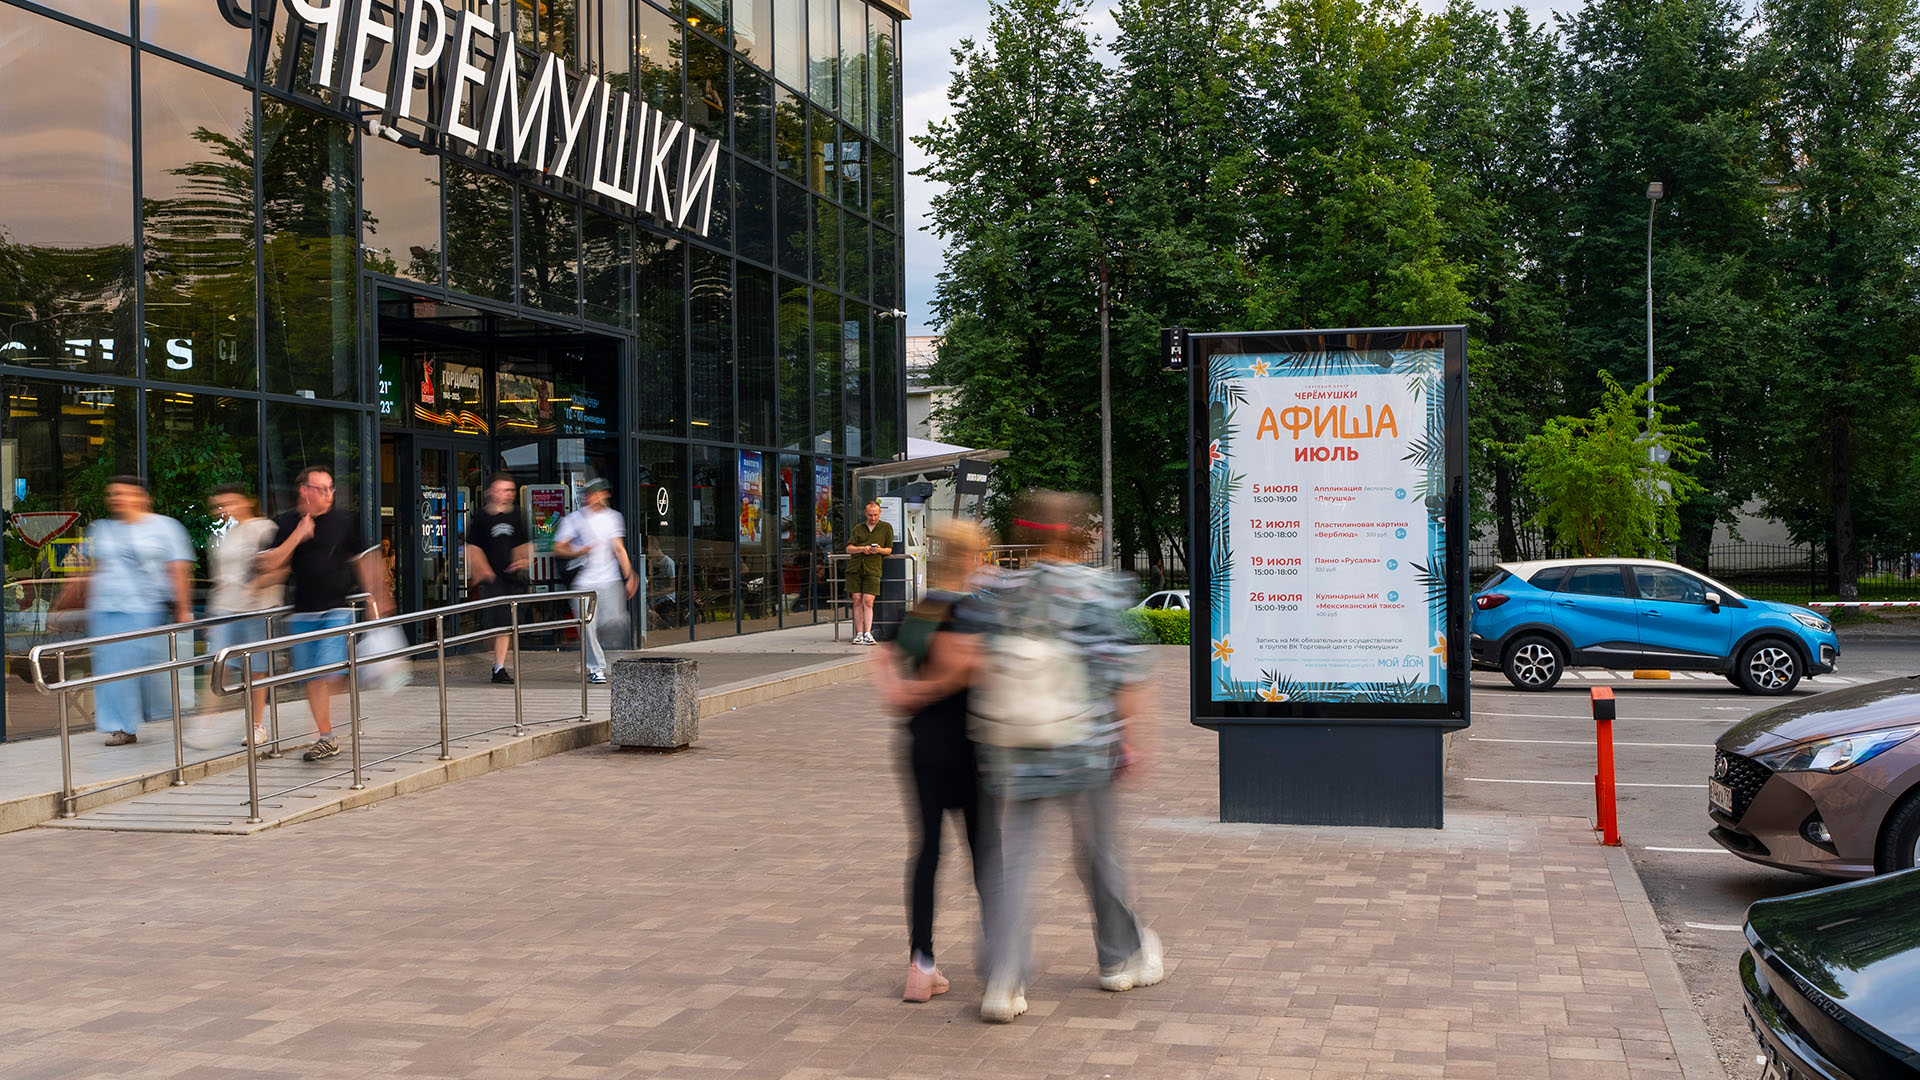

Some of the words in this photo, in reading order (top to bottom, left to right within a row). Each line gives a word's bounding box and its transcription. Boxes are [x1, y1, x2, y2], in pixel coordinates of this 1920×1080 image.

[1295, 390, 1357, 400] ЧЕРЁМУШКИ
[1256, 403, 1398, 440] АФИША
[1294, 446, 1359, 462] ИЮЛЬ
[1253, 484, 1260, 493] 5
[1263, 484, 1299, 493] июля
[1250, 519, 1262, 528] 12
[1265, 520, 1300, 528] июля
[1251, 557, 1263, 566] 19
[1267, 558, 1301, 566] июля
[1341, 557, 1380, 565] «Русалка»
[1250, 592, 1265, 601] 26
[1268, 593, 1302, 601] июля
[1377, 656, 1399, 667] МОЙ
[1402, 655, 1424, 667] ДОМ
